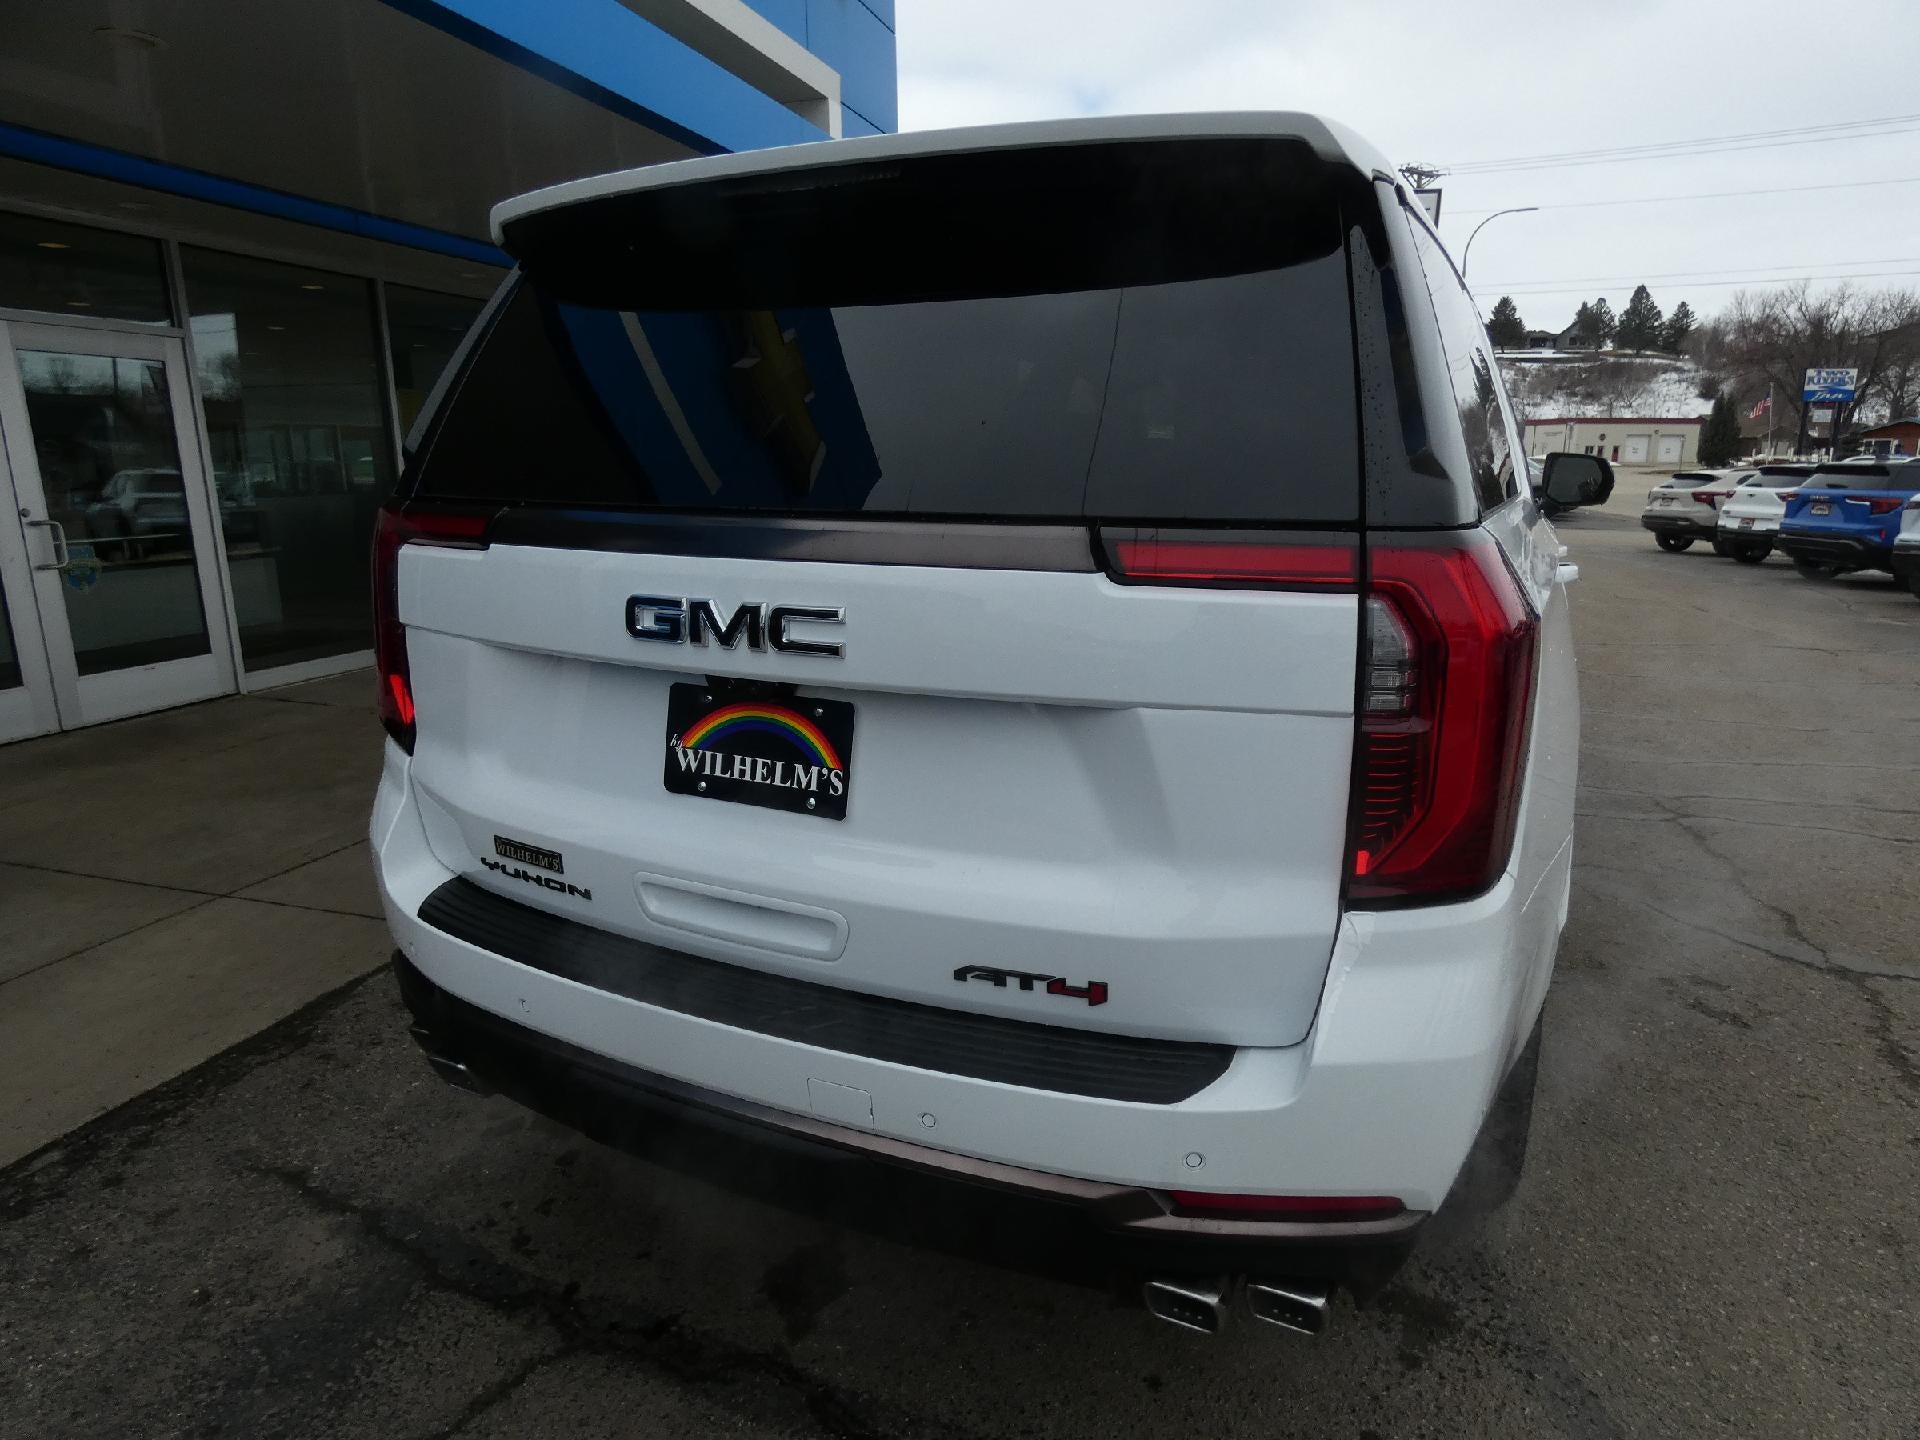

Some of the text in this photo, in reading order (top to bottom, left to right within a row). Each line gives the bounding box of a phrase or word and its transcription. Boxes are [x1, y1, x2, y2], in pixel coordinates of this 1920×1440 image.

[625, 594, 847, 659] GMC
[676, 749, 844, 796] WILHELM'S
[495, 840, 560, 872] WILHELM'S
[480, 857, 592, 900] YUKON
[953, 964, 1108, 1006] AT4
